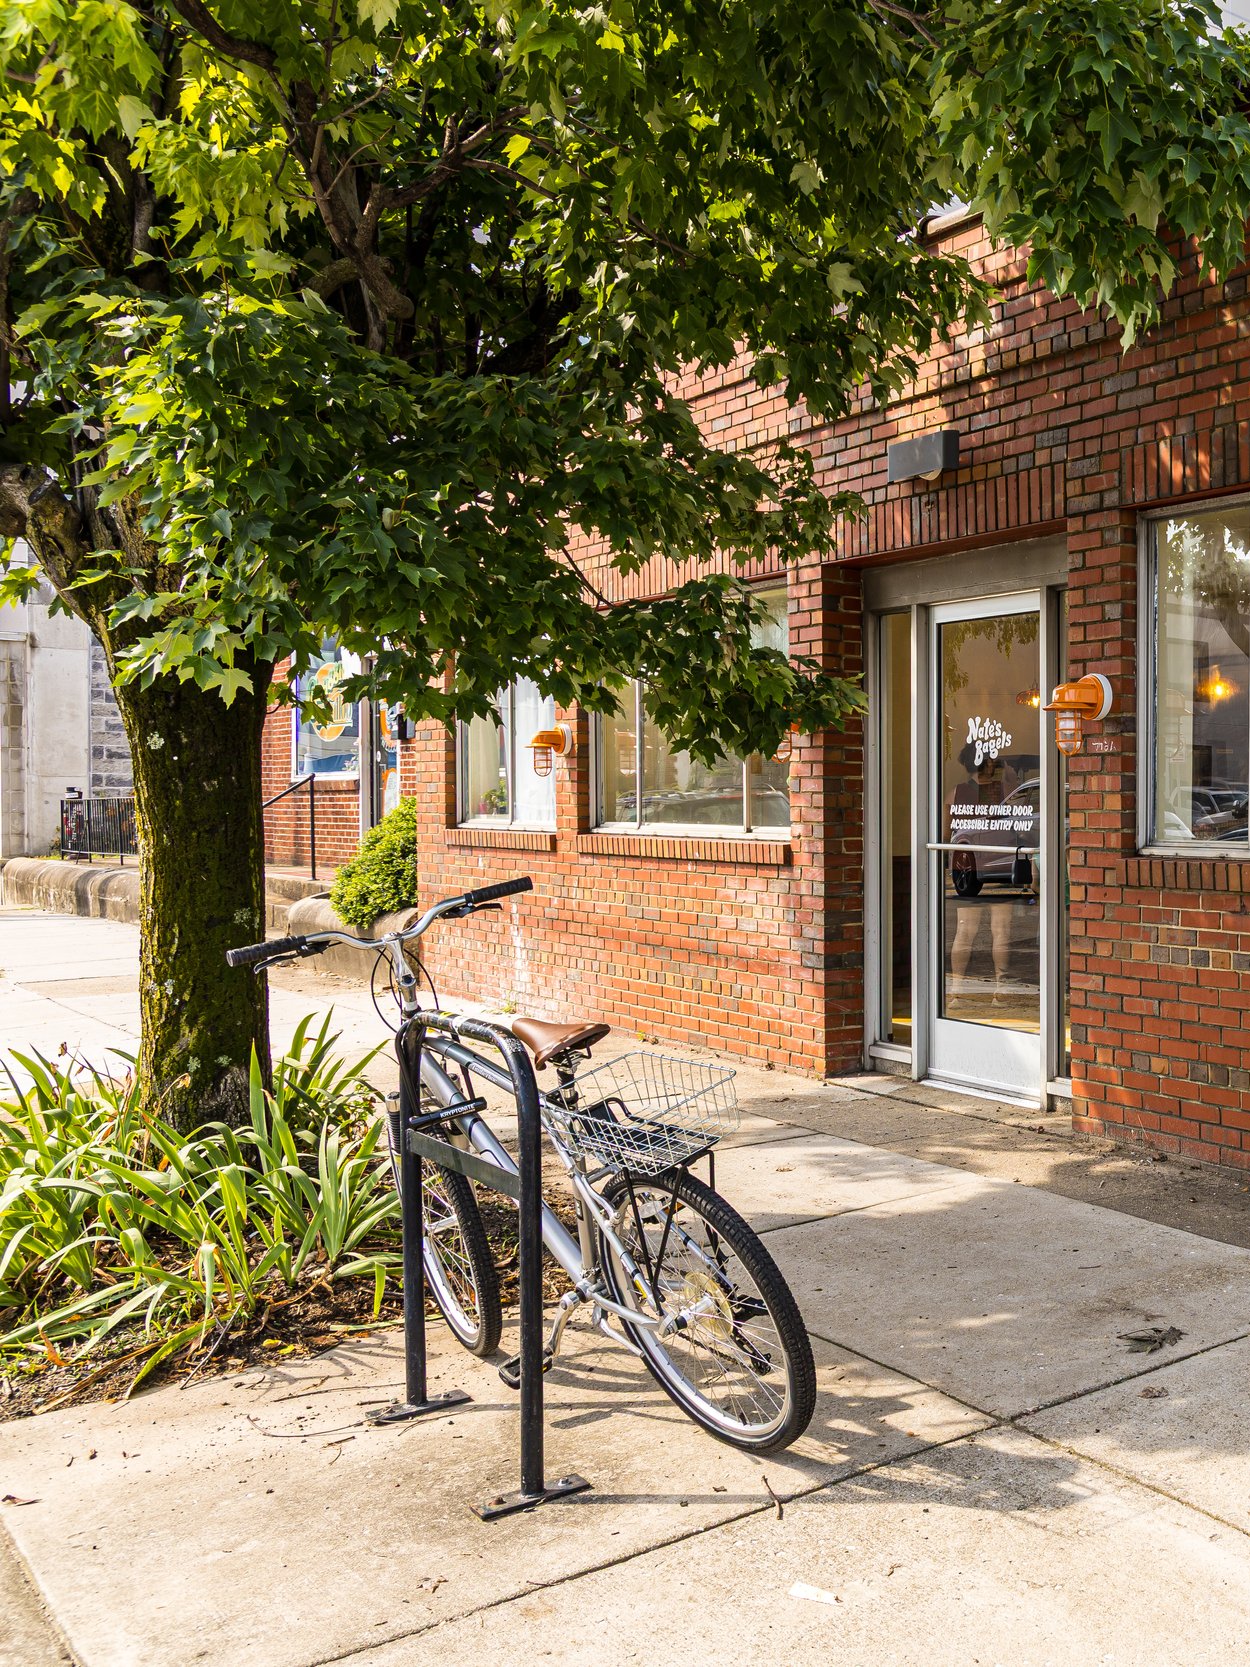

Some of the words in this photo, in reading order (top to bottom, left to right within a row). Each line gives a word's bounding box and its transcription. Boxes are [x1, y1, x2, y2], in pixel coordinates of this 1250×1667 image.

[967, 716, 1002, 744] Nate's
[973, 731, 1012, 766] Bagels
[950, 804, 974, 815] PLEASE
[974, 804, 989, 815] USE
[988, 805, 1012, 816] OTHER
[1012, 805, 1034, 816] DOOR
[950, 819, 989, 830] ACCESSIBLE
[989, 819, 1014, 831] ENTRY
[1013, 820, 1034, 831] ONLY
[440, 1103, 474, 1118] KRYPTONITE
